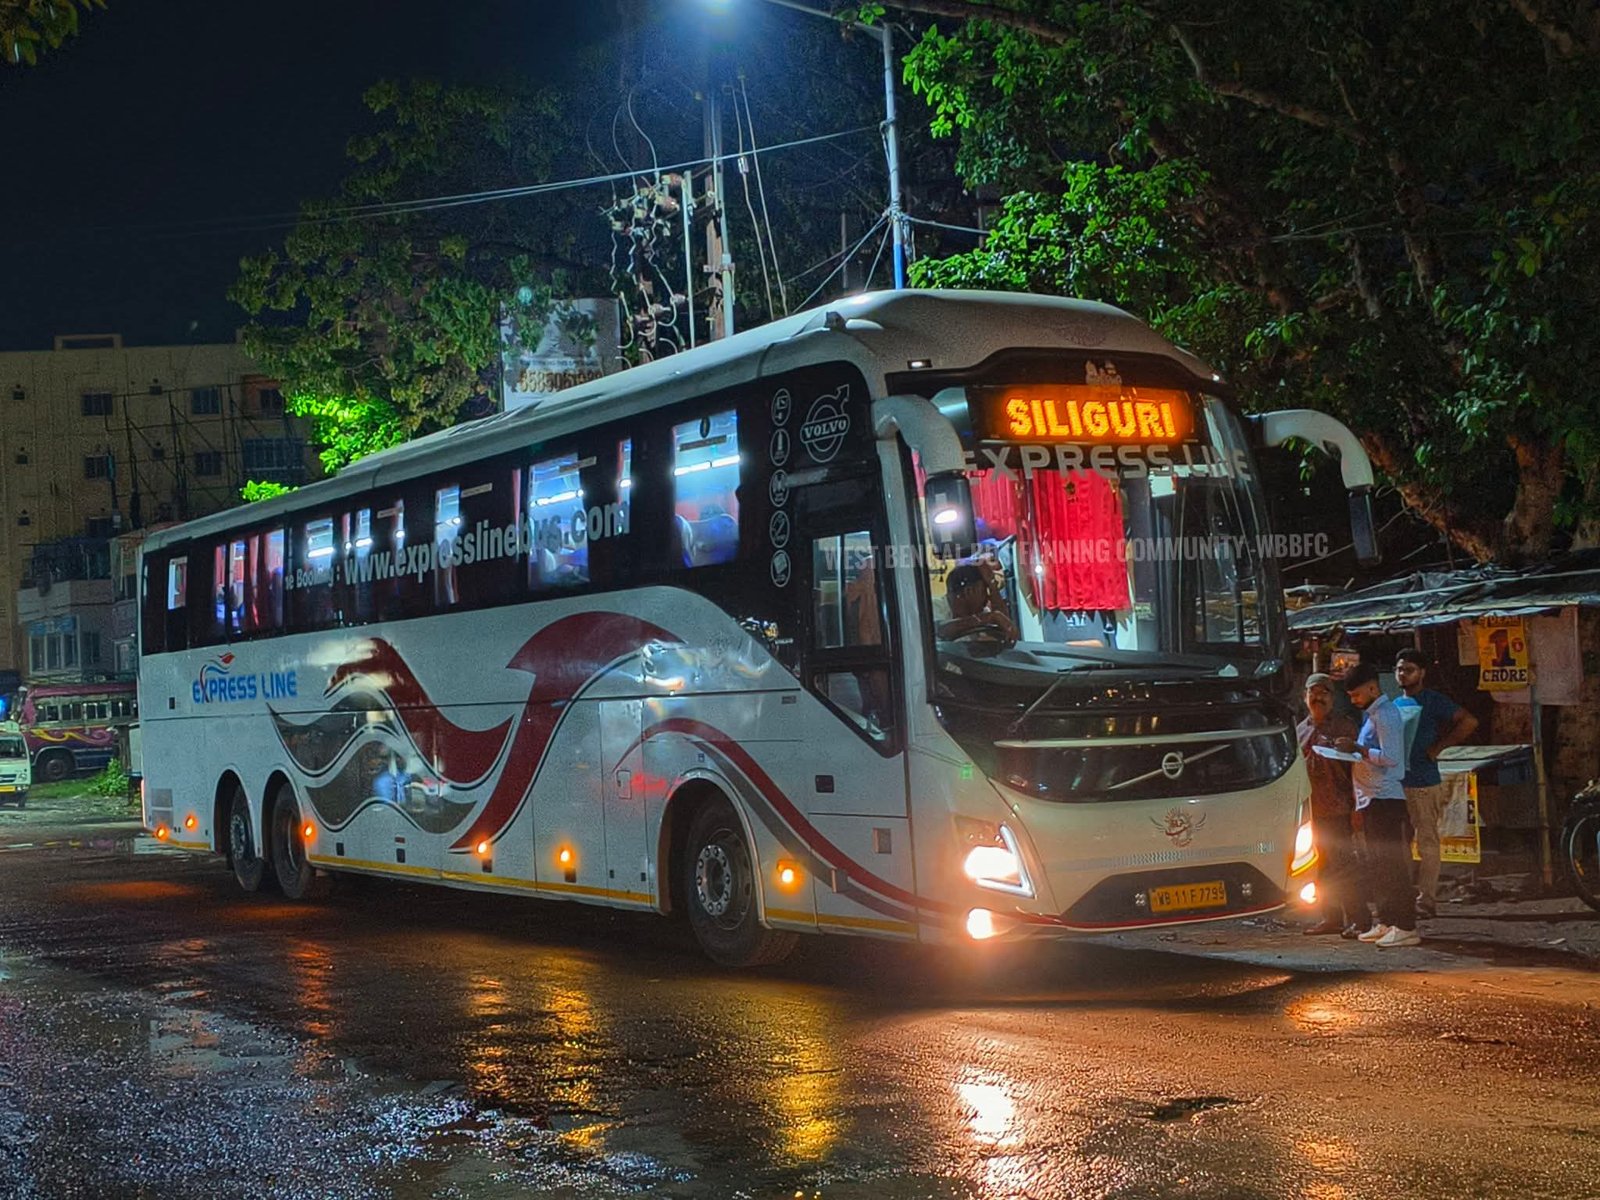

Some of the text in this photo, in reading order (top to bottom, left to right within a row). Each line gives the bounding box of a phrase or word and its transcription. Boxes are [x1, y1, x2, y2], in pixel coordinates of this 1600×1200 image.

[804, 420, 847, 439] VOLVO
[1006, 398, 1176, 438] SILIGURI
[344, 500, 630, 585] www.expresslinebus.com
[1489, 629, 1516, 666] 1
[192, 671, 297, 703] EXPRESS LINE
[1483, 669, 1527, 682] CRORE
